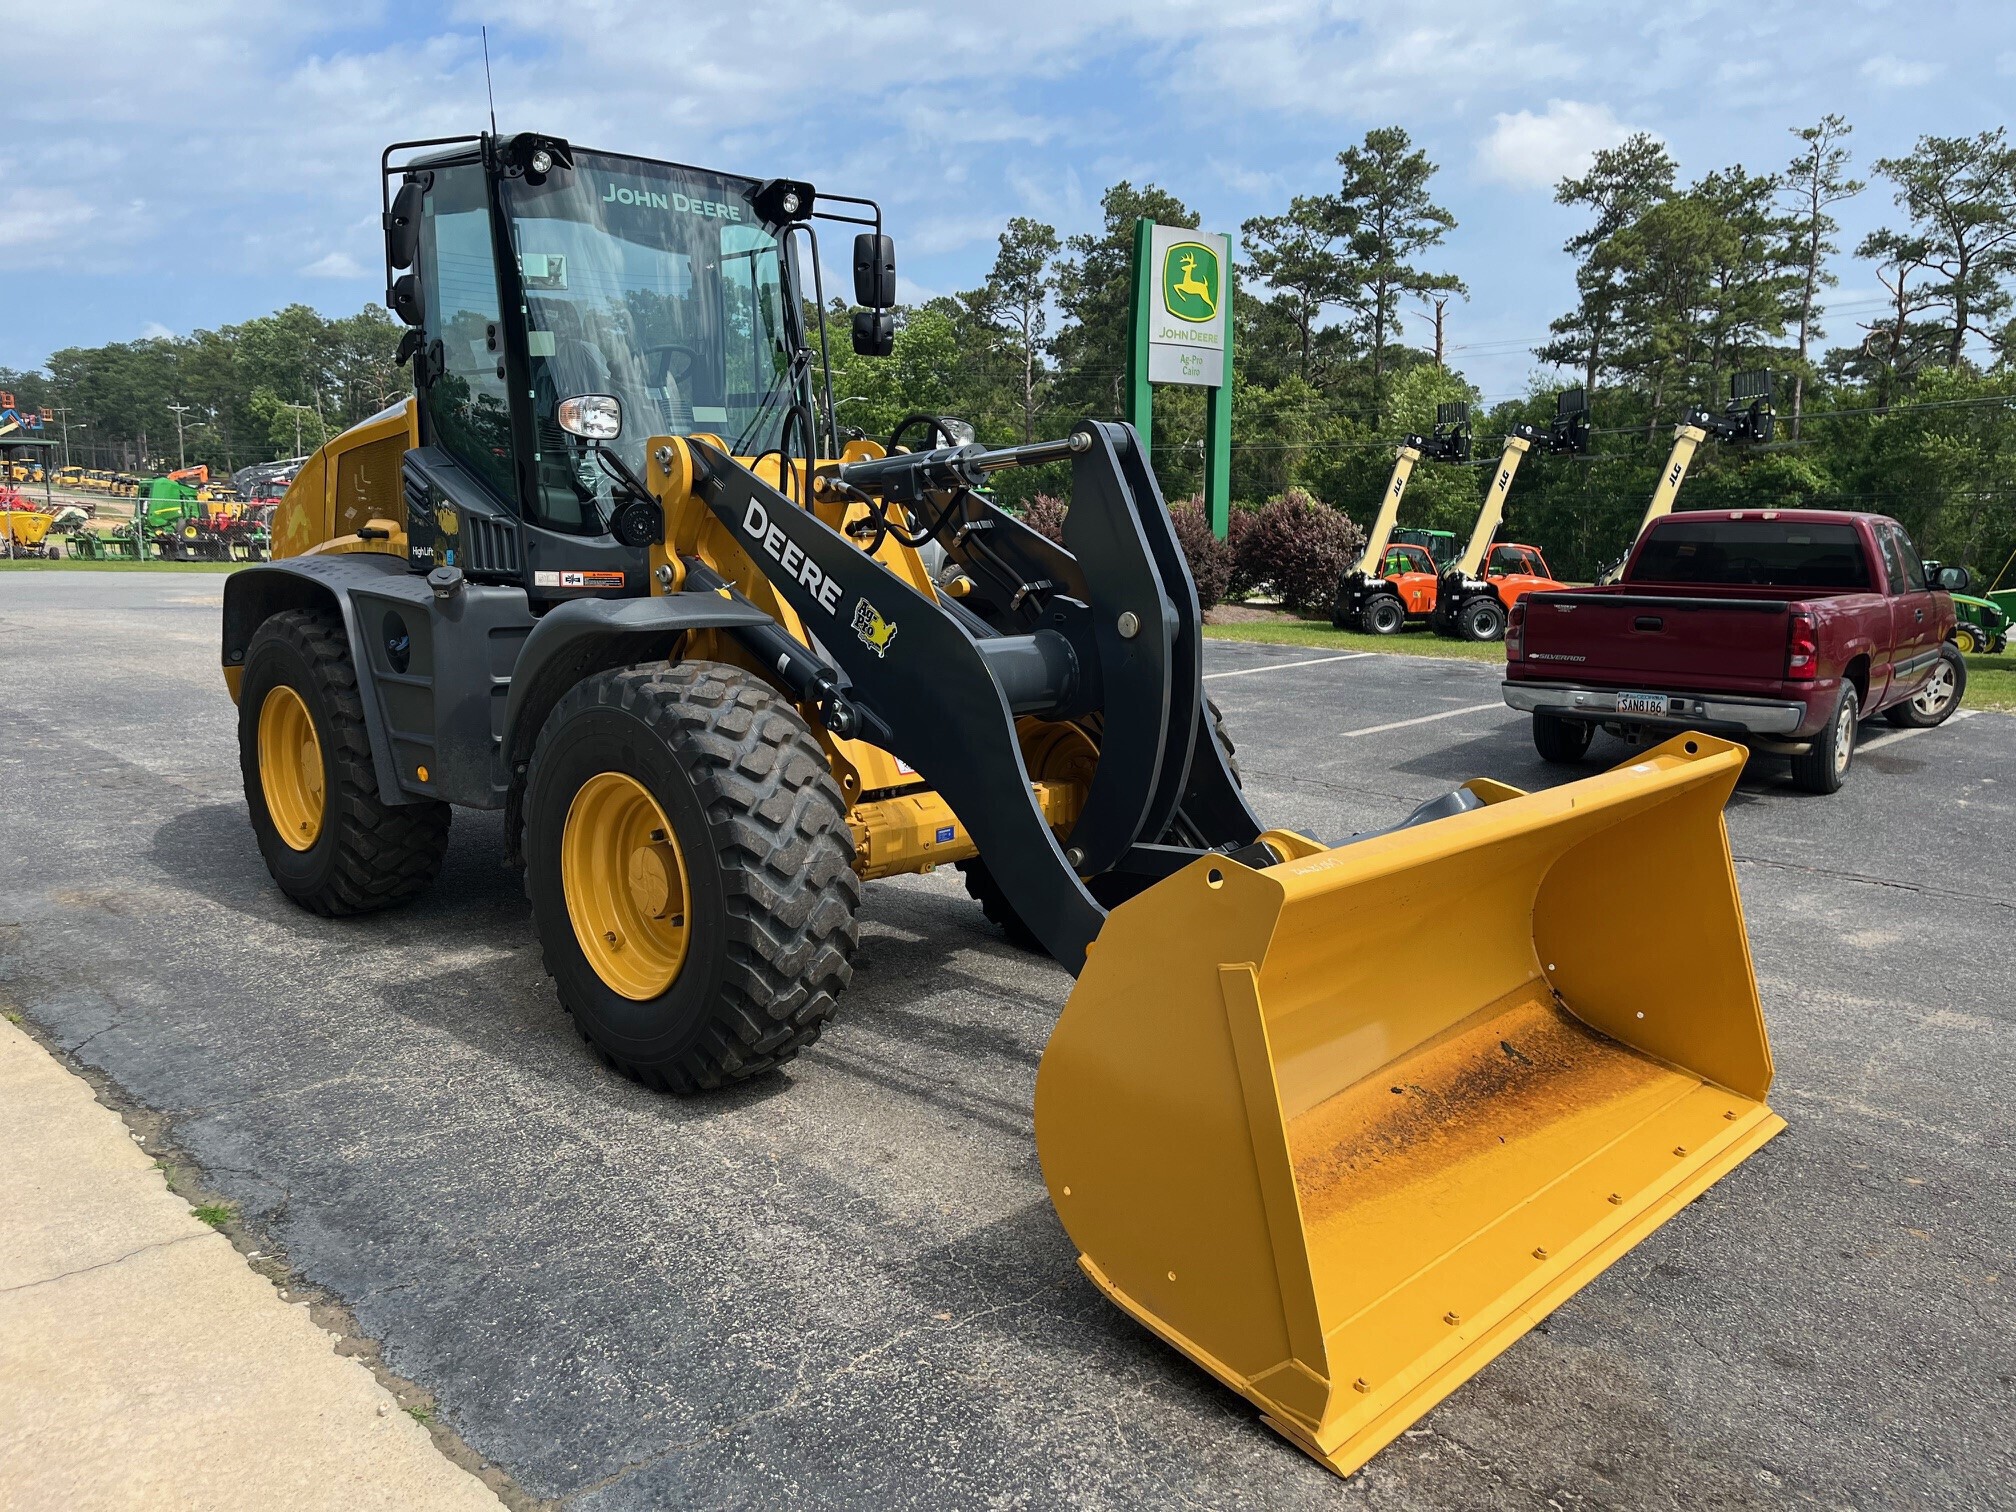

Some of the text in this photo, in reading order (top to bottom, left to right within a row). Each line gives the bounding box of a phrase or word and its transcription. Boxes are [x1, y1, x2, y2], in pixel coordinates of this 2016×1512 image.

[602, 183, 742, 222] JOHN DEERE
[1159, 326, 1219, 344] JOHN DEERE
[1180, 354, 1203, 366] Ag-Pro
[1182, 365, 1201, 377] Cairo
[1498, 469, 1510, 492] JLG
[1669, 462, 1682, 488] JLG
[1393, 476, 1403, 498] JLG
[742, 496, 843, 616] DEERE
[854, 613, 874, 636] Pro
[1539, 653, 1587, 662] SILVERADO
[1622, 699, 1662, 713] SAN8186
